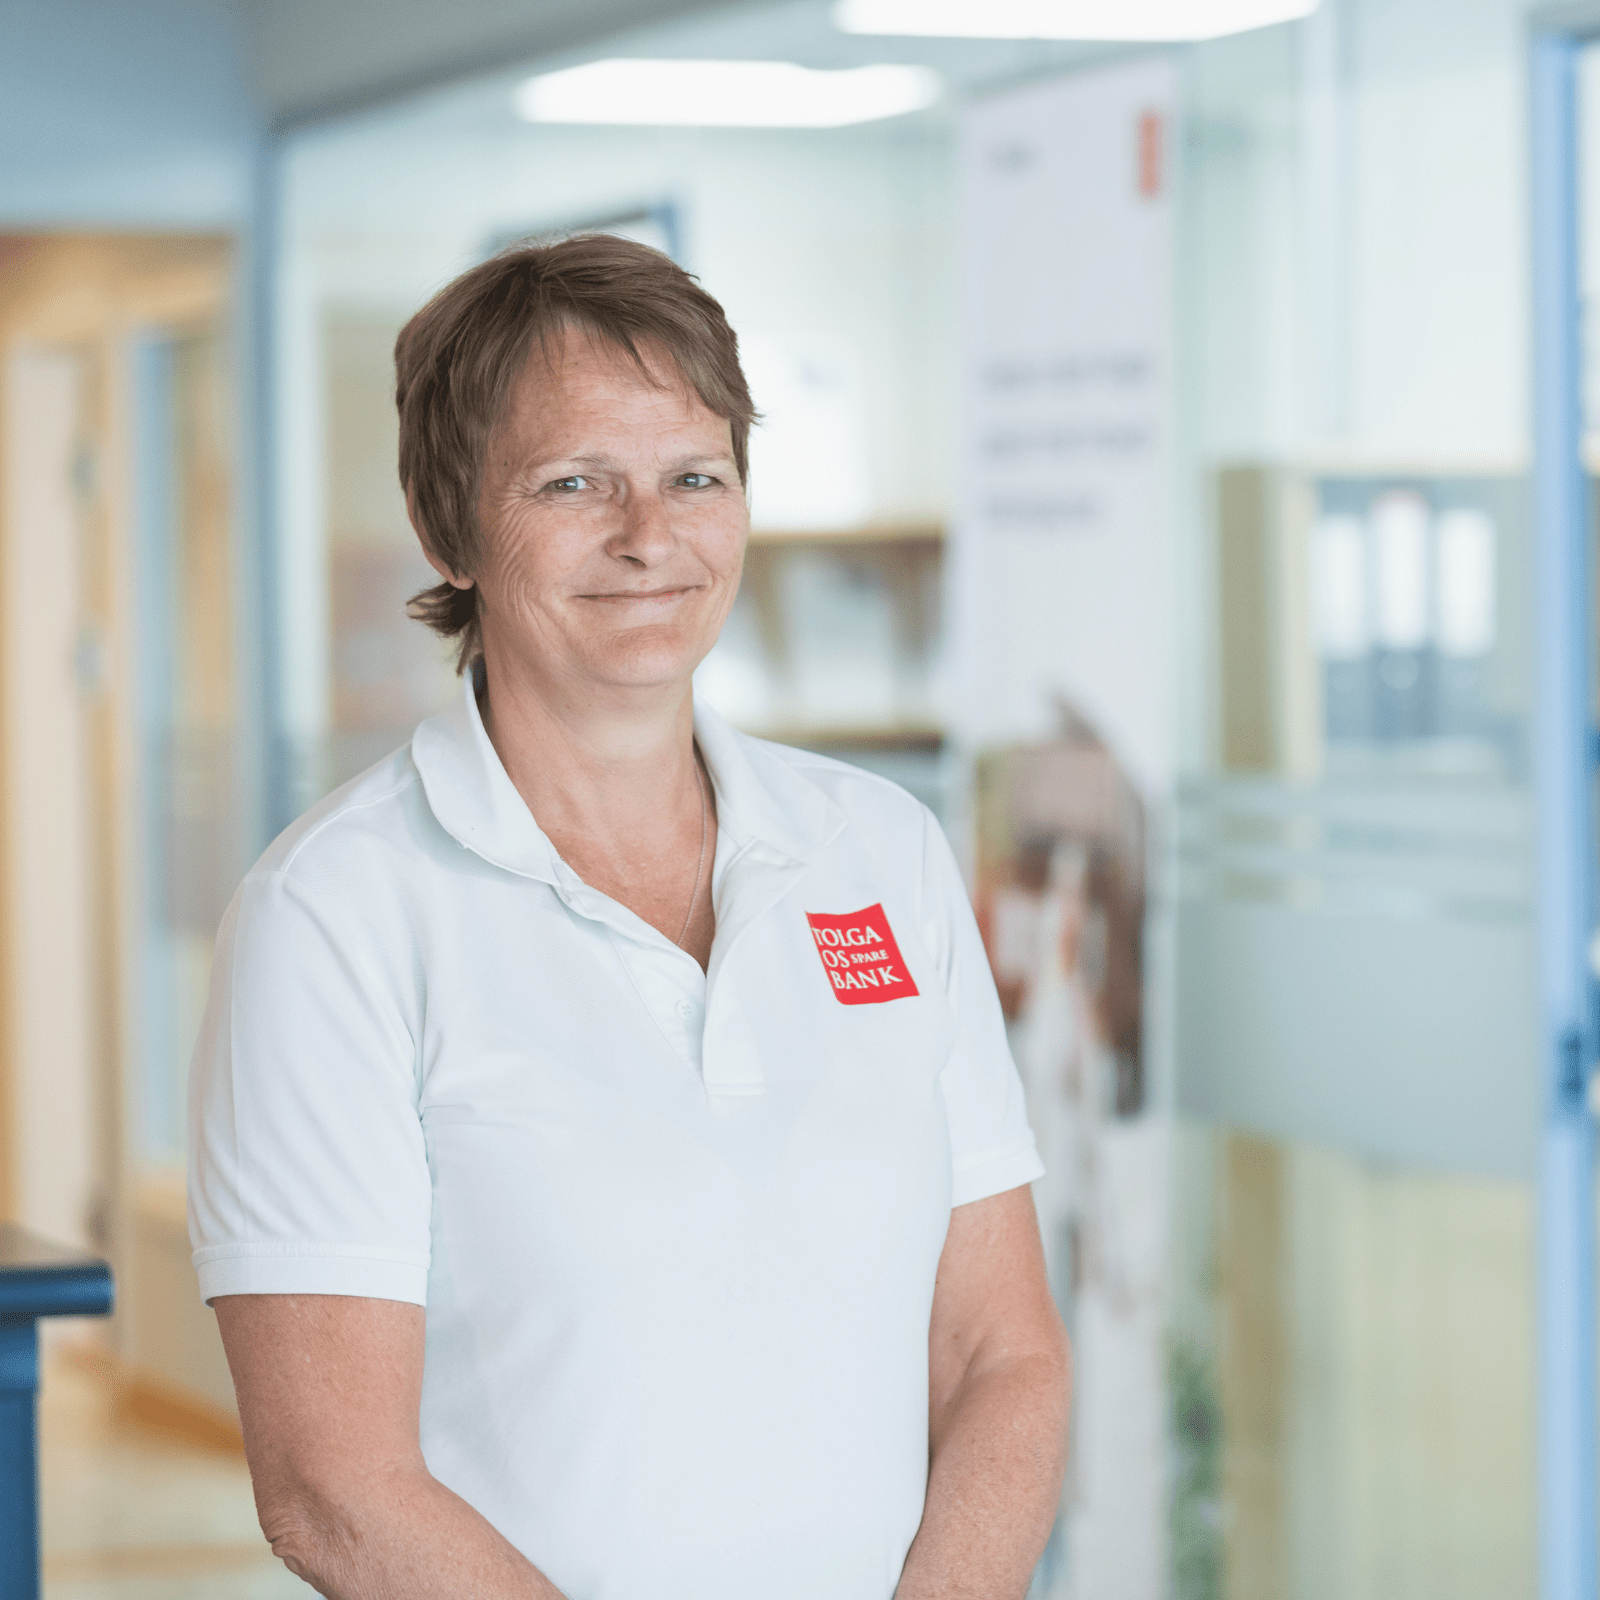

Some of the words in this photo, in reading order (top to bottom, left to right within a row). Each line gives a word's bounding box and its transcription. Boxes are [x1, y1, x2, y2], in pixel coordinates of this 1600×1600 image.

[811, 925, 884, 947] TOLGA
[822, 949, 850, 968] OS
[850, 949, 889, 964] SPARE
[830, 965, 904, 990] BANK
